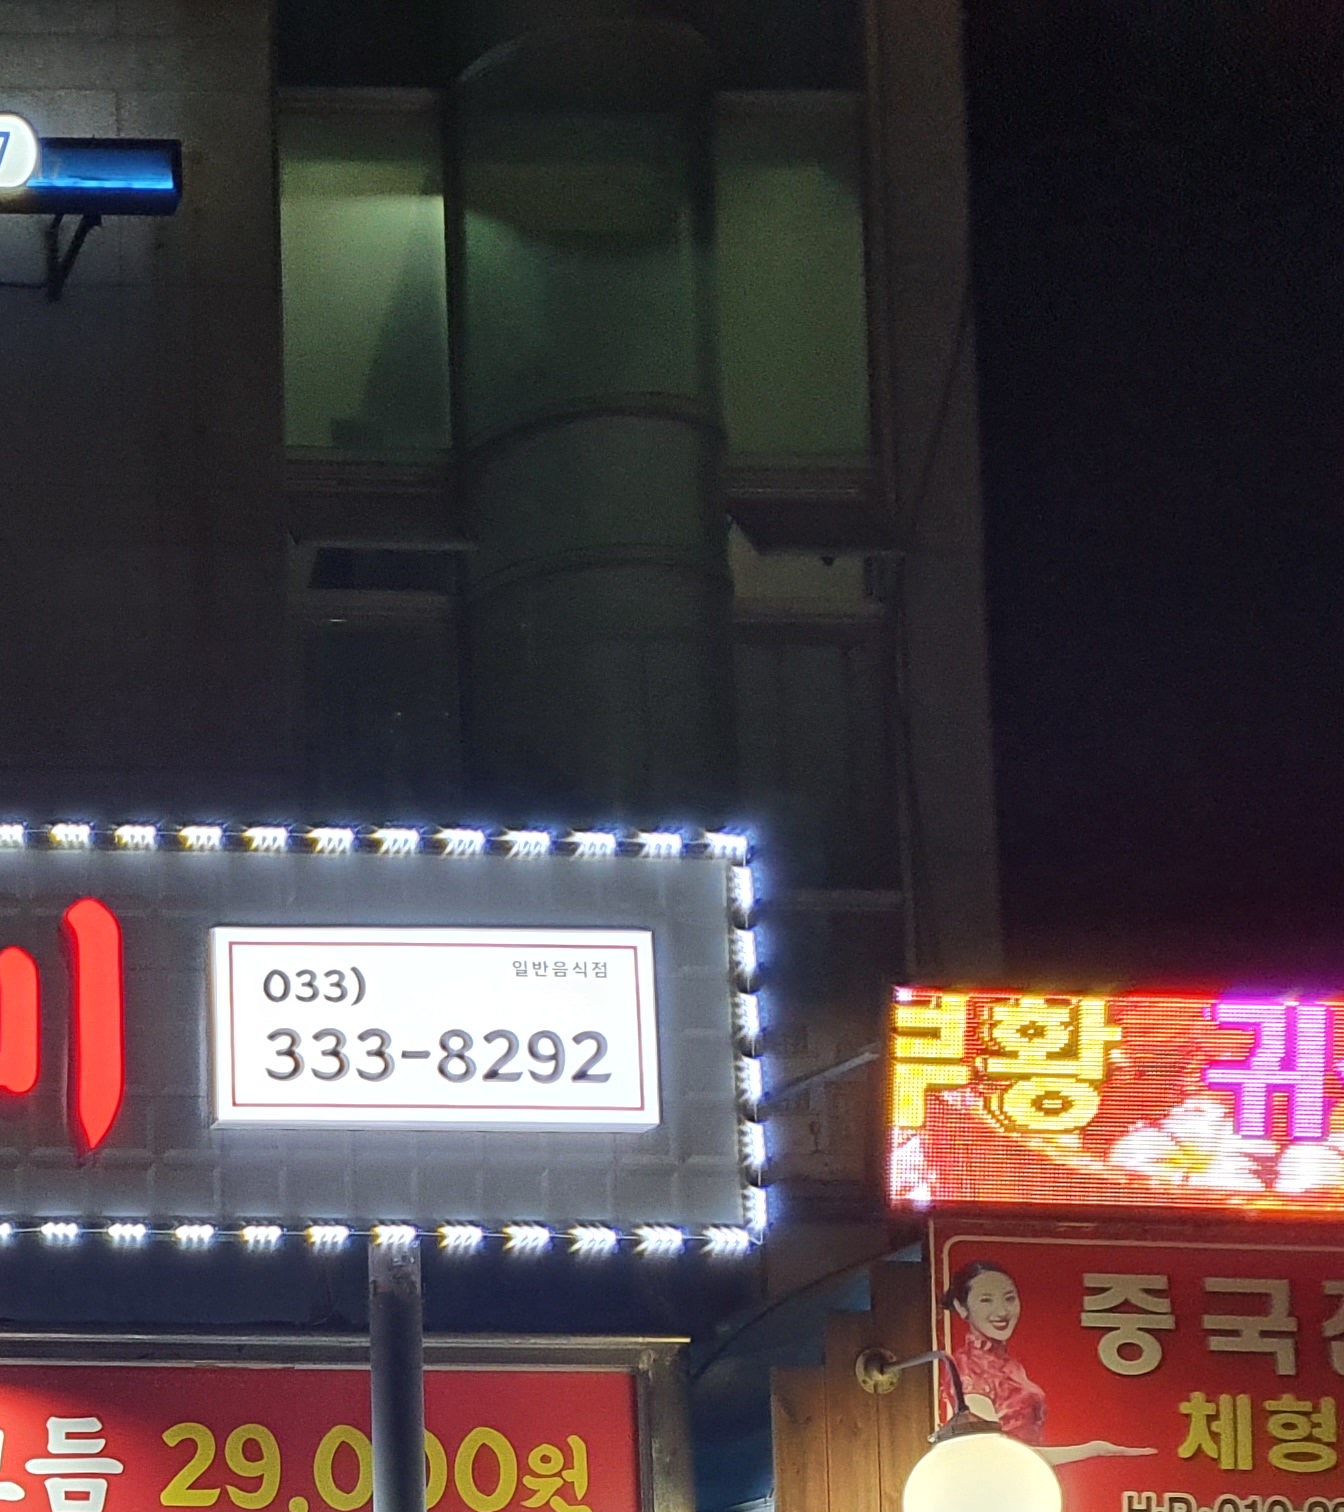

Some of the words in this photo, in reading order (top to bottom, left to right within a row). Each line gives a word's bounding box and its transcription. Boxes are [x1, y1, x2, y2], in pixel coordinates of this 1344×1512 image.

[262, 965, 367, 1007] 033)
[511, 958, 610, 980] 일반음식점
[264, 1026, 614, 1085] 333-8292
[1201, 998, 1344, 1141] 귀
[1177, 1390, 1338, 1474] 체형
